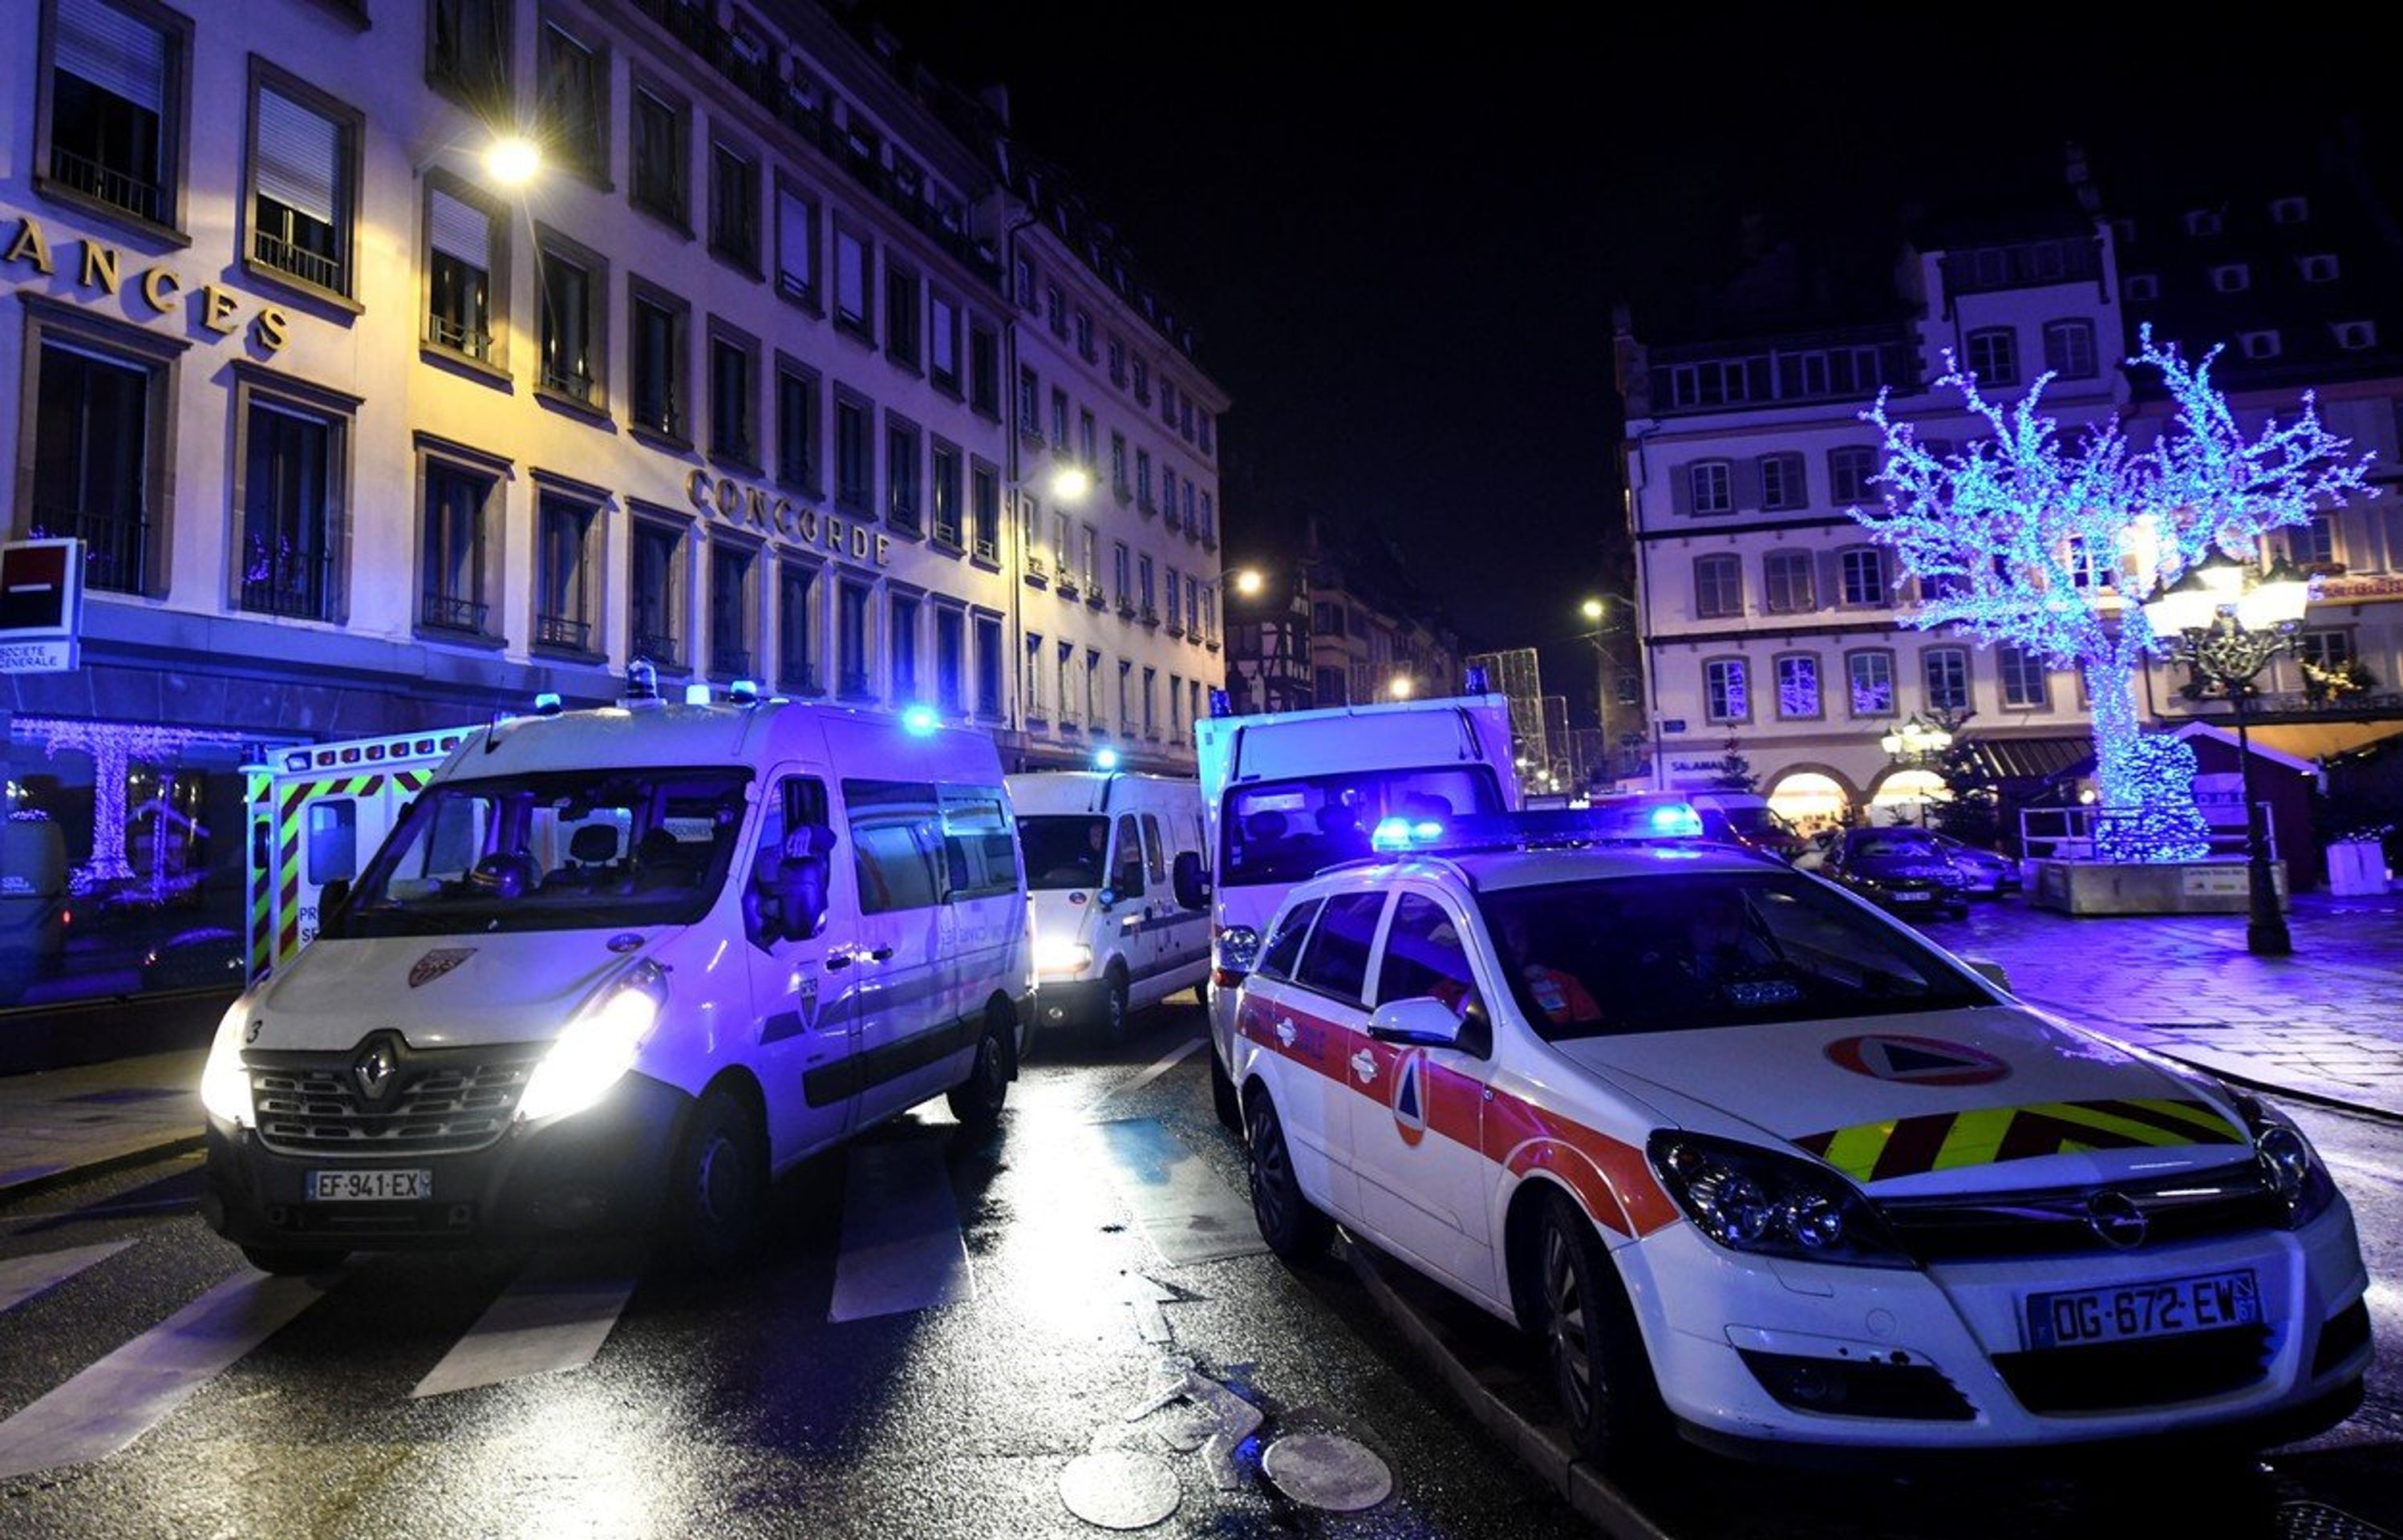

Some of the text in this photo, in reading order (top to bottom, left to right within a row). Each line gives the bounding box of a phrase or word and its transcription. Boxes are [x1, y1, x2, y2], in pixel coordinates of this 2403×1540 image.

[685, 468, 890, 568] CONCORDE
[246, 1019, 262, 1044] 3
[319, 1173, 418, 1197] EF-941-EX
[2052, 1280, 2236, 1341] DG-672-EW
